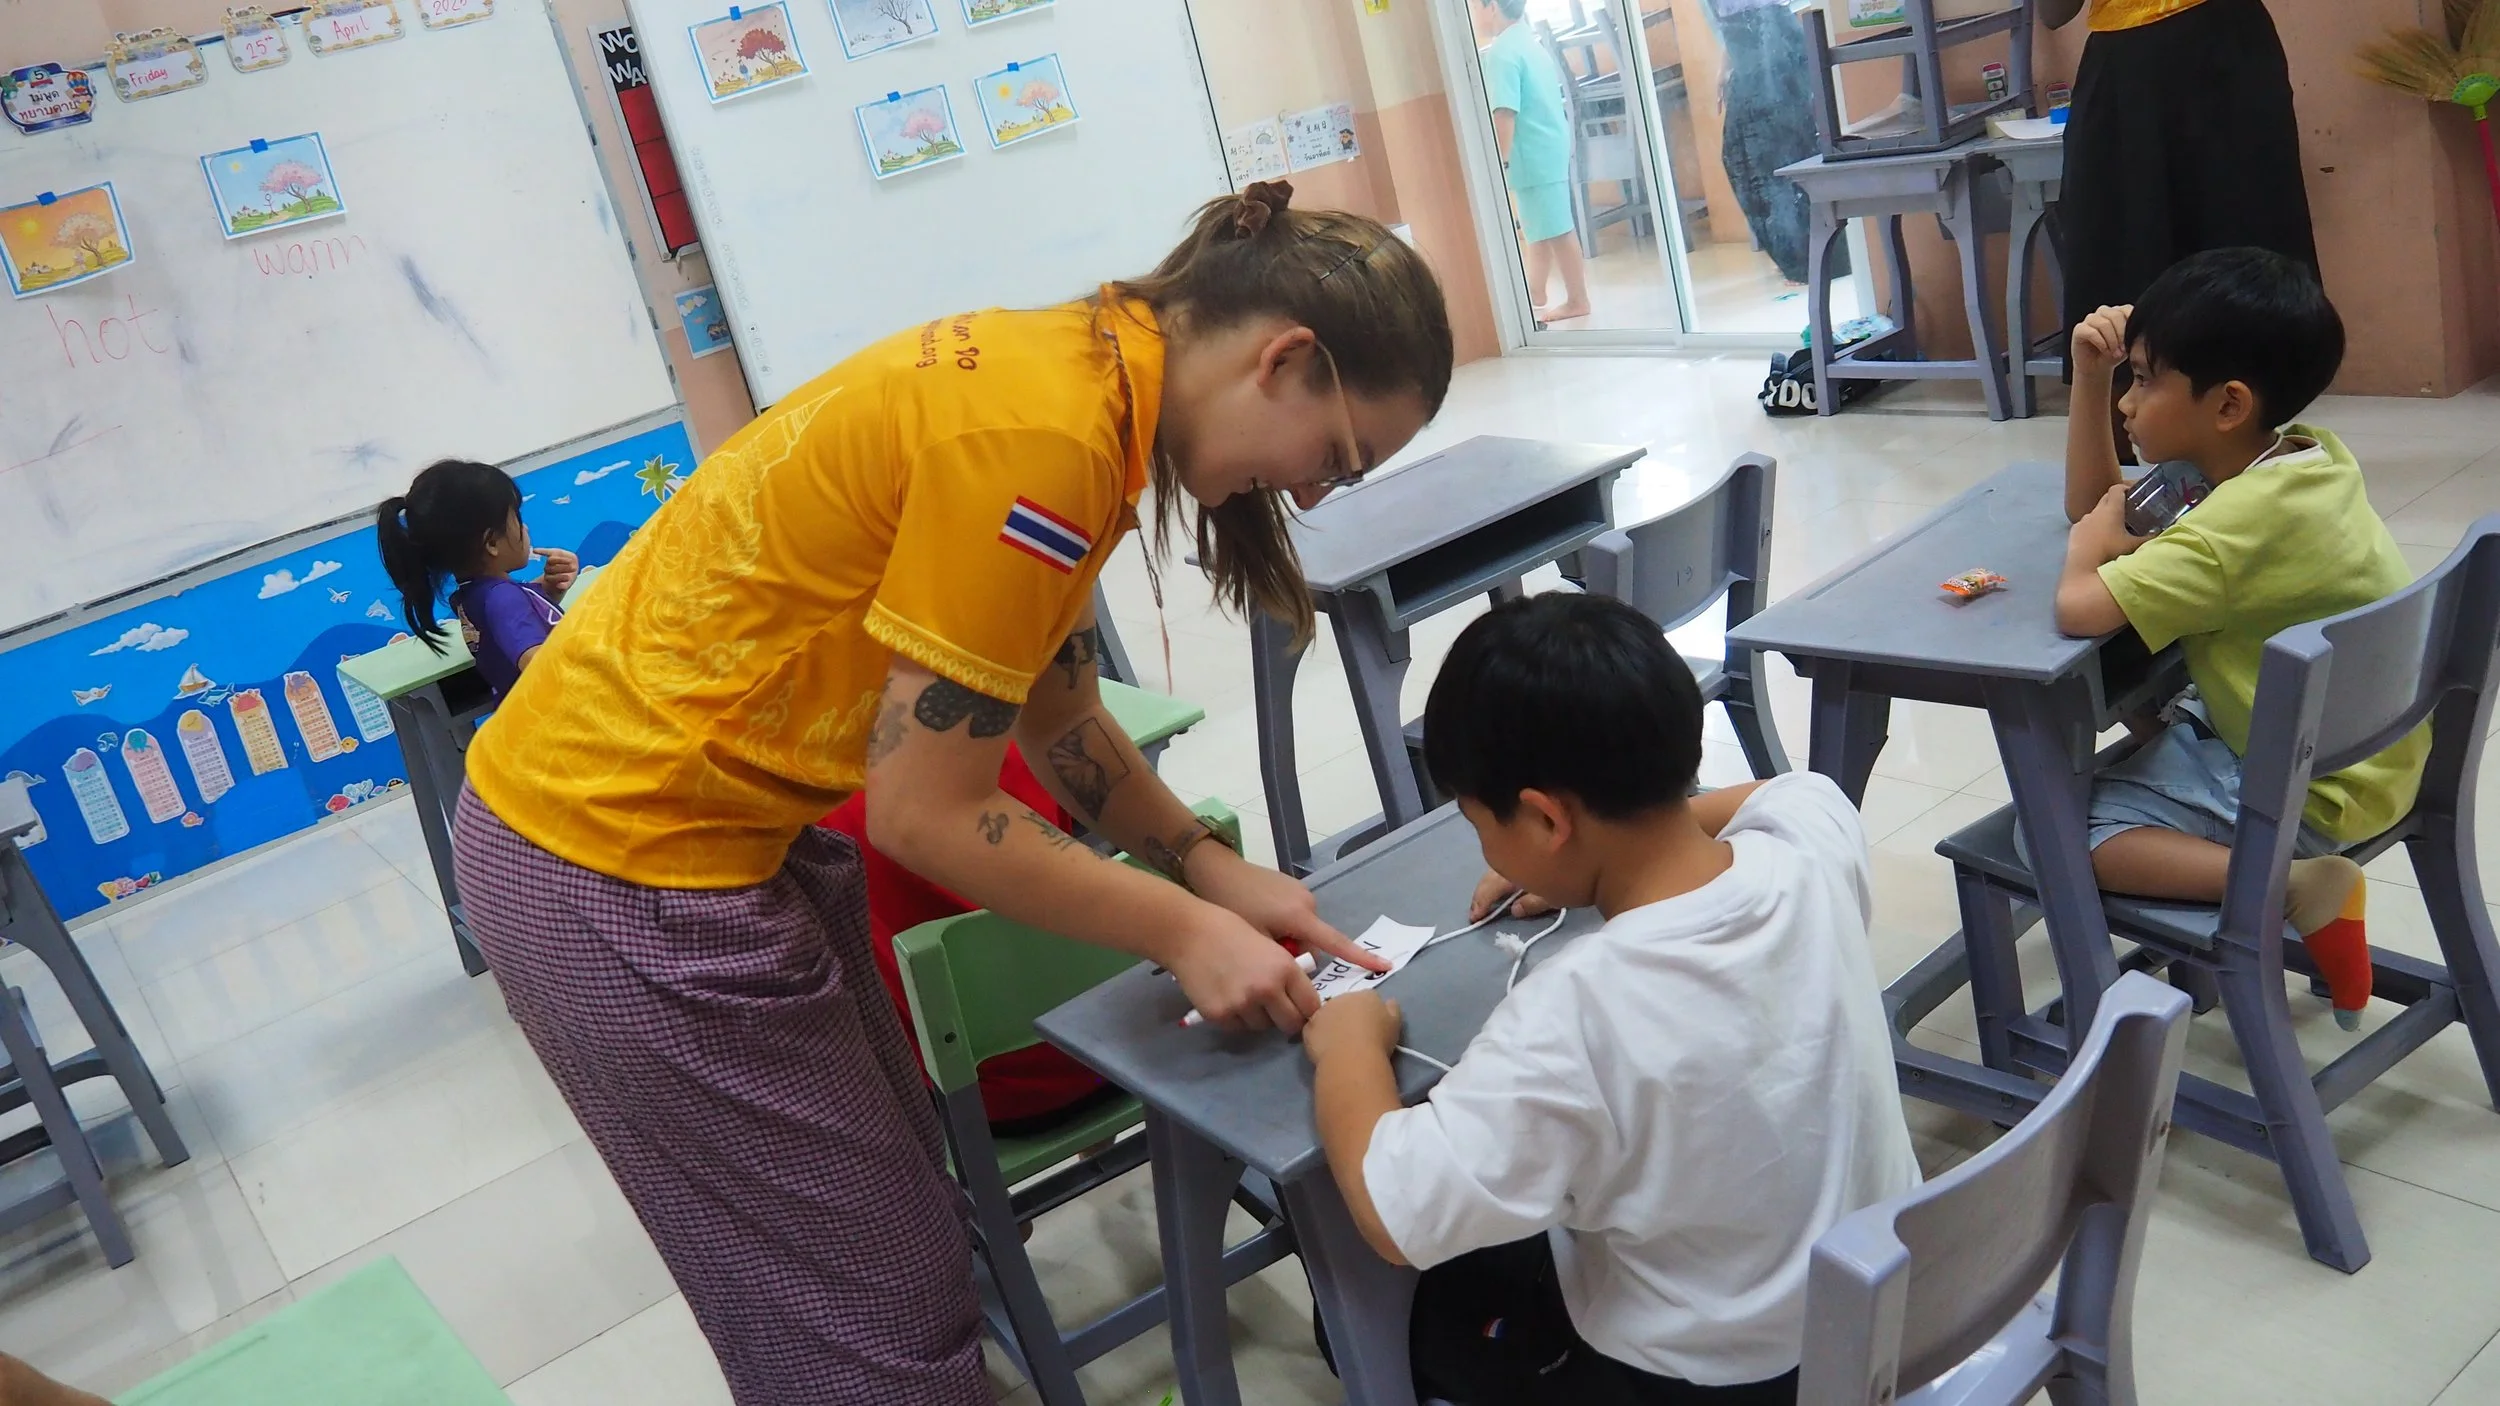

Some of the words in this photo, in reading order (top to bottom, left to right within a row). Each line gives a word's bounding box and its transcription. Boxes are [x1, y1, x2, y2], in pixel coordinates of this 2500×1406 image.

[333, 16, 369, 40] April
[34, 70, 44, 80] 5
[129, 67, 168, 87] Friday
[254, 235, 366, 276] warm
[46, 294, 169, 368] hot
